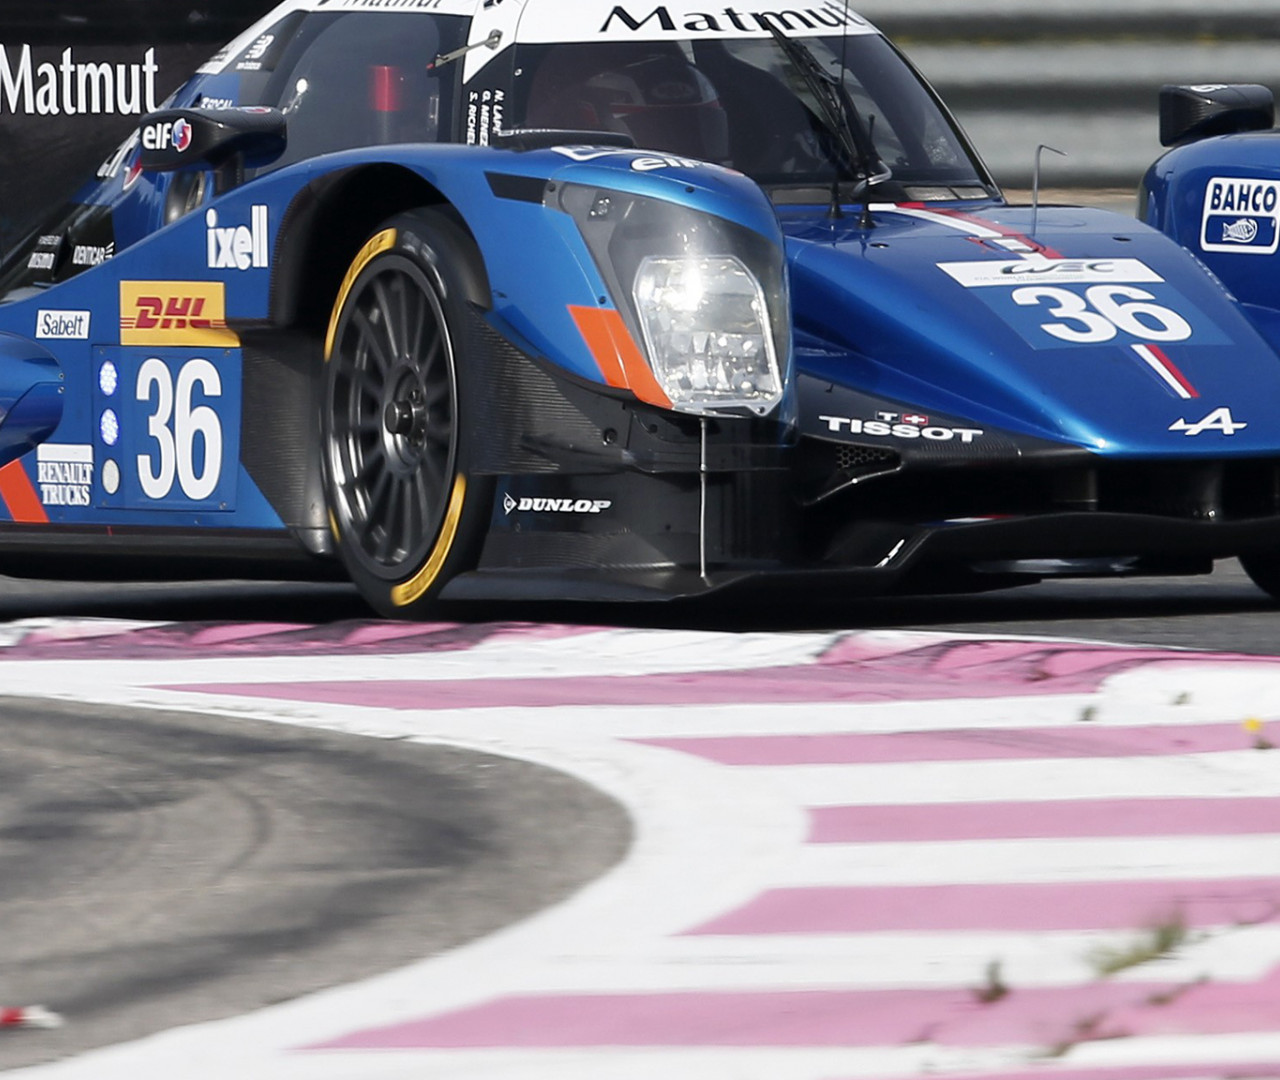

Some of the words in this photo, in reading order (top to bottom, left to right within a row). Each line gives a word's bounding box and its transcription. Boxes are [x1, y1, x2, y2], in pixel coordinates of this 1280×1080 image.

[598, 0, 867, 33] Matmut
[142, 122, 171, 150] elf
[480, 104, 490, 146] MENEZ
[1210, 183, 1277, 213] BAHCO
[206, 205, 269, 270] ixell
[1001, 261, 1115, 275] WEC
[42, 313, 83, 336] Sabelt
[135, 297, 211, 329] DHL
[1010, 284, 1193, 343] 36
[135, 357, 222, 501] 36
[818, 415, 984, 443] TISSOT
[37, 461, 94, 485] RENAULT
[40, 483, 91, 506] TRUCKS
[517, 497, 612, 513] DUNLOP
